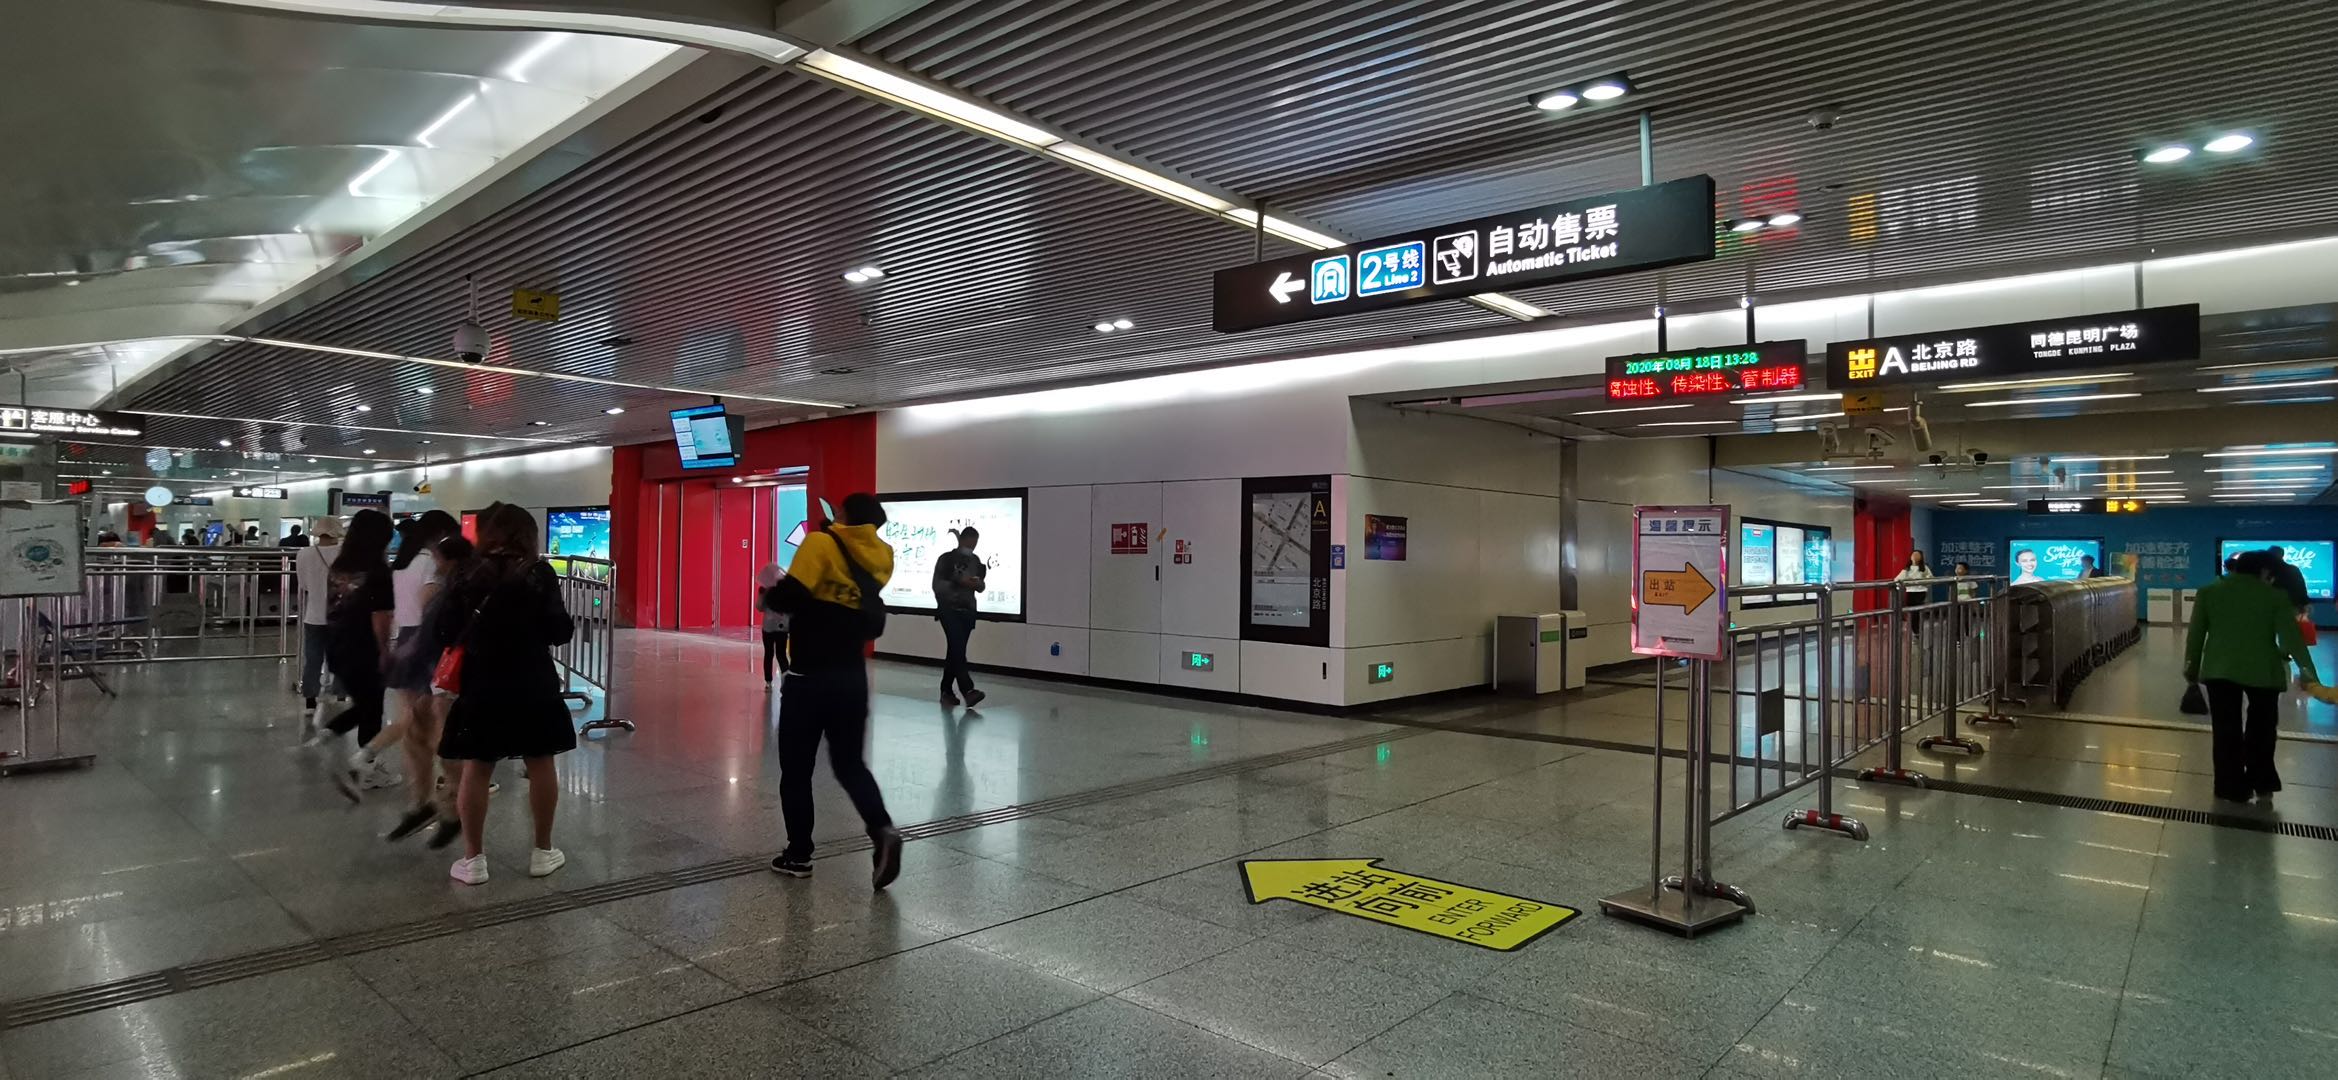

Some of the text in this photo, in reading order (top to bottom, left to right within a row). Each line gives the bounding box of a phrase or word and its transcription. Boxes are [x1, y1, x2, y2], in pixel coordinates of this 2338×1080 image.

[1489, 204, 1619, 258] 自动售票
[1486, 242, 1618, 277] Automatic Ticket
[1384, 270, 1418, 287] Line 2
[2030, 323, 2139, 349] 同德昆明广场
[1911, 338, 1978, 361] 北京路
[2068, 345, 2104, 355] KUNMING
[2109, 342, 2136, 351] PLAZA
[1878, 346, 1909, 376] A
[1911, 358, 1978, 372] BEIJING RD
[1848, 369, 1876, 379] EXIT
[31, 410, 101, 427] 客服中心
[1313, 500, 1326, 518] A
[1649, 519, 1712, 532] 温馨提示
[1649, 579, 1675, 591] 出站
[1290, 870, 1396, 903] 进站
[1353, 881, 1454, 918] 向前
[1427, 898, 1494, 925] ENTER
[1456, 902, 1543, 941] FORWARD
